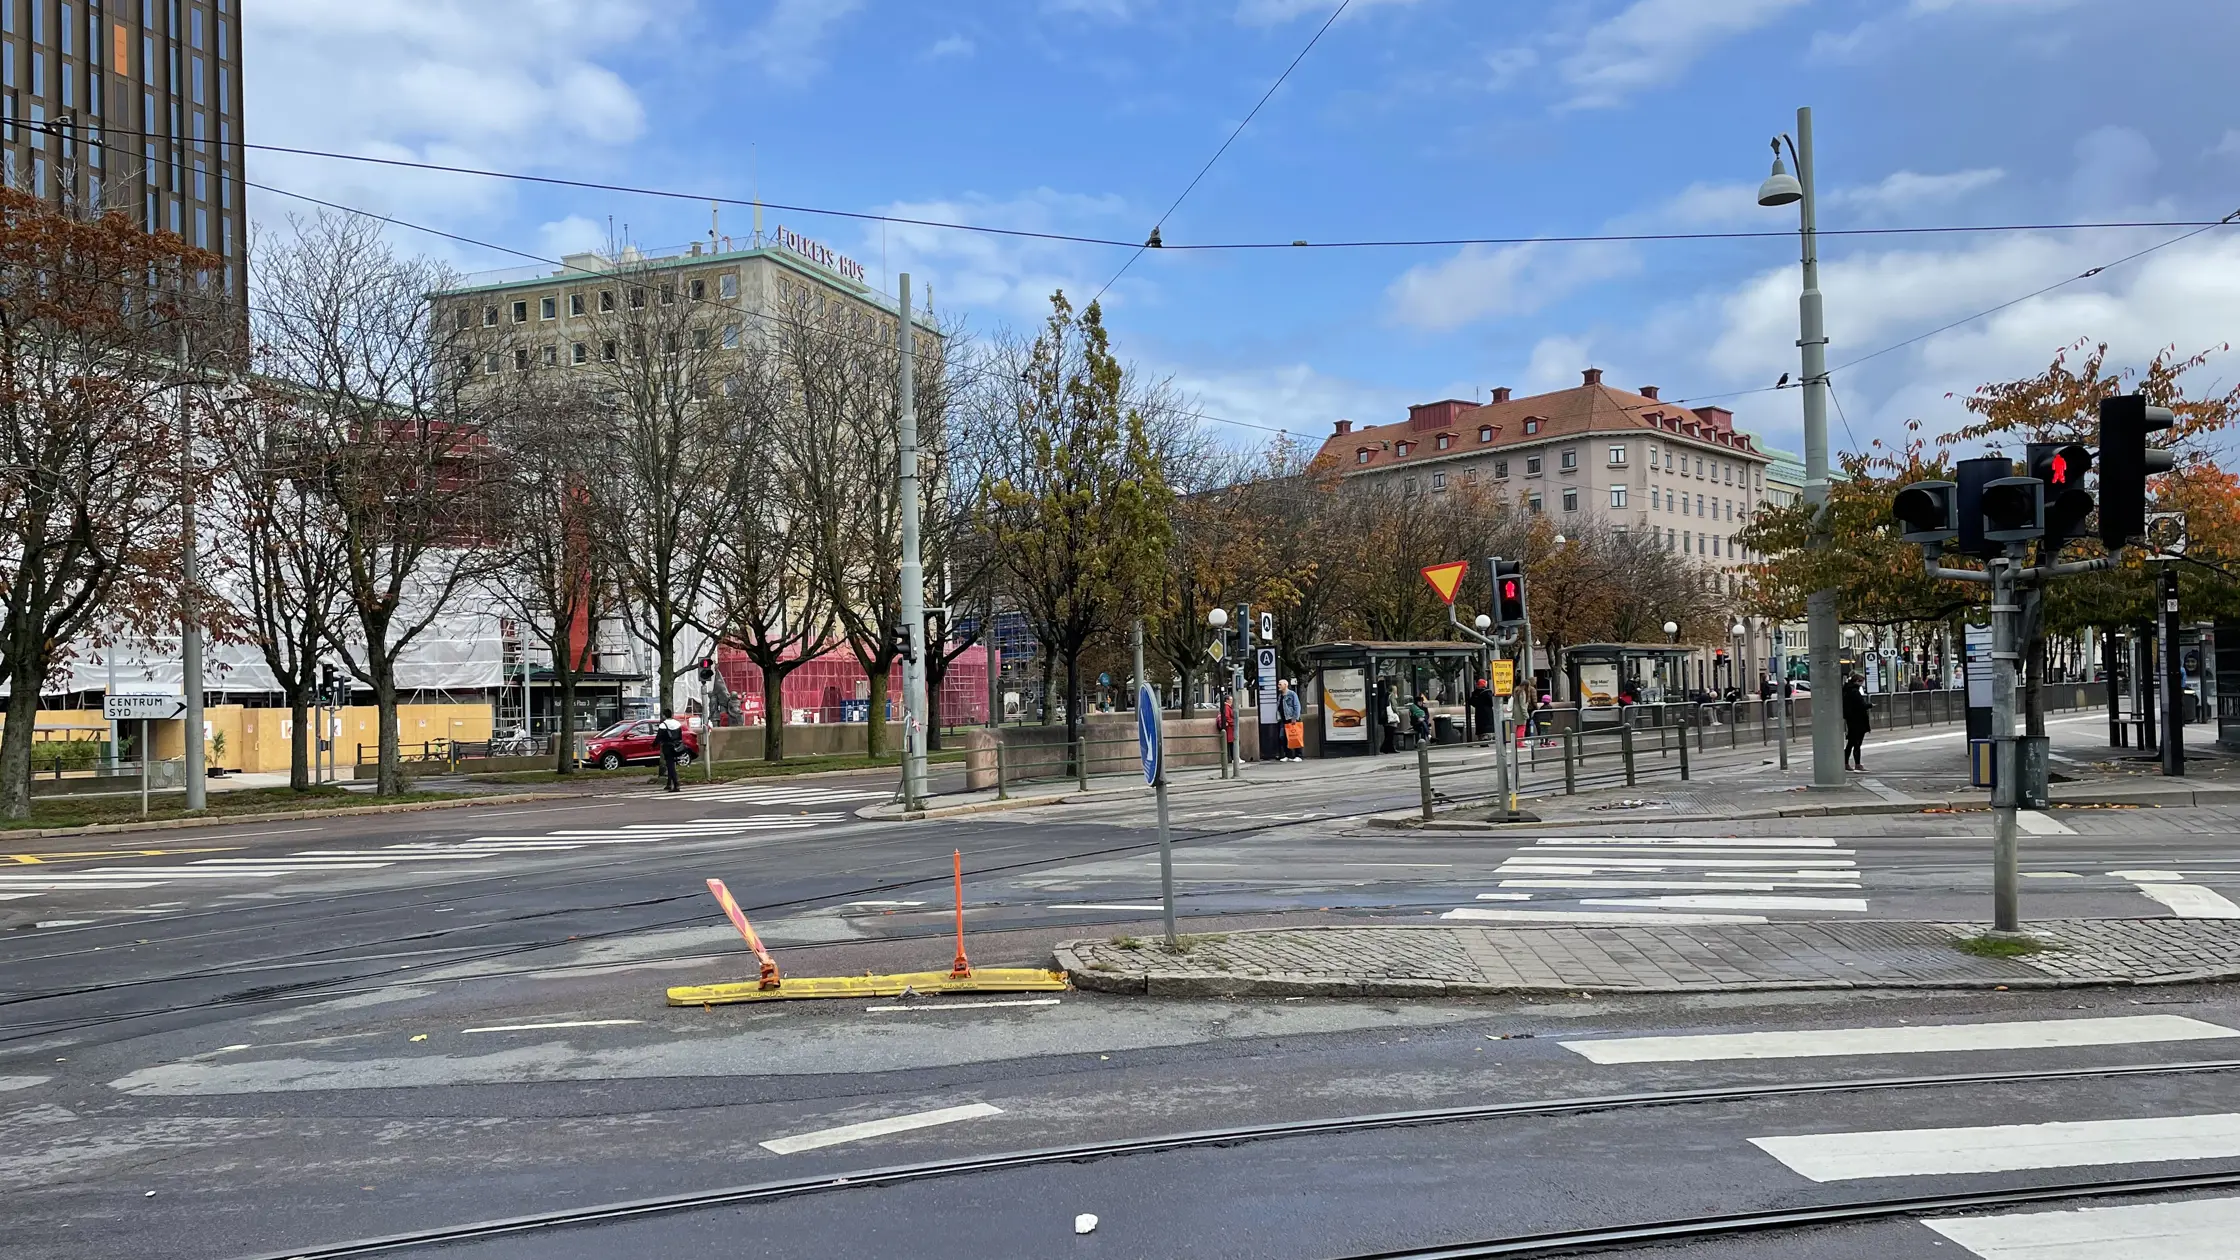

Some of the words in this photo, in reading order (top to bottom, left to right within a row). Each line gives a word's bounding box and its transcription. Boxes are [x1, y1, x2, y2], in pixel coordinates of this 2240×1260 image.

[778, 224, 834, 268] FOLKETS
[840, 254, 865, 283] HUS
[109, 698, 163, 707] CENTRUM
[109, 708, 131, 717] SYD
